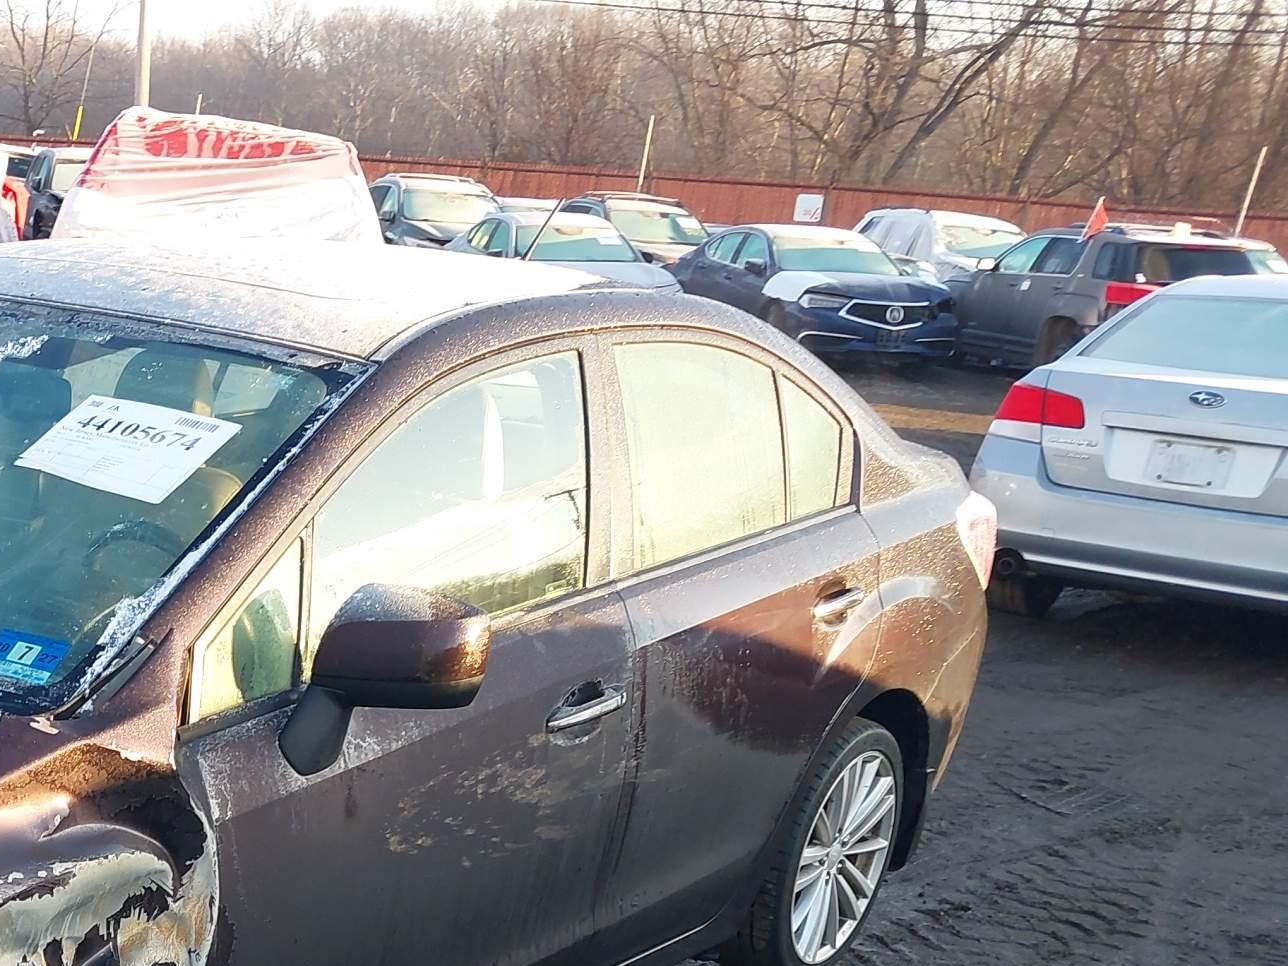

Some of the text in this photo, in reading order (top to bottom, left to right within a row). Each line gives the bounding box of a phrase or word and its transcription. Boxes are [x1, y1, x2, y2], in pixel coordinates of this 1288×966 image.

[77, 415, 203, 451] 44105674
[18, 645, 35, 661] 7
[37, 652, 59, 665] 27
